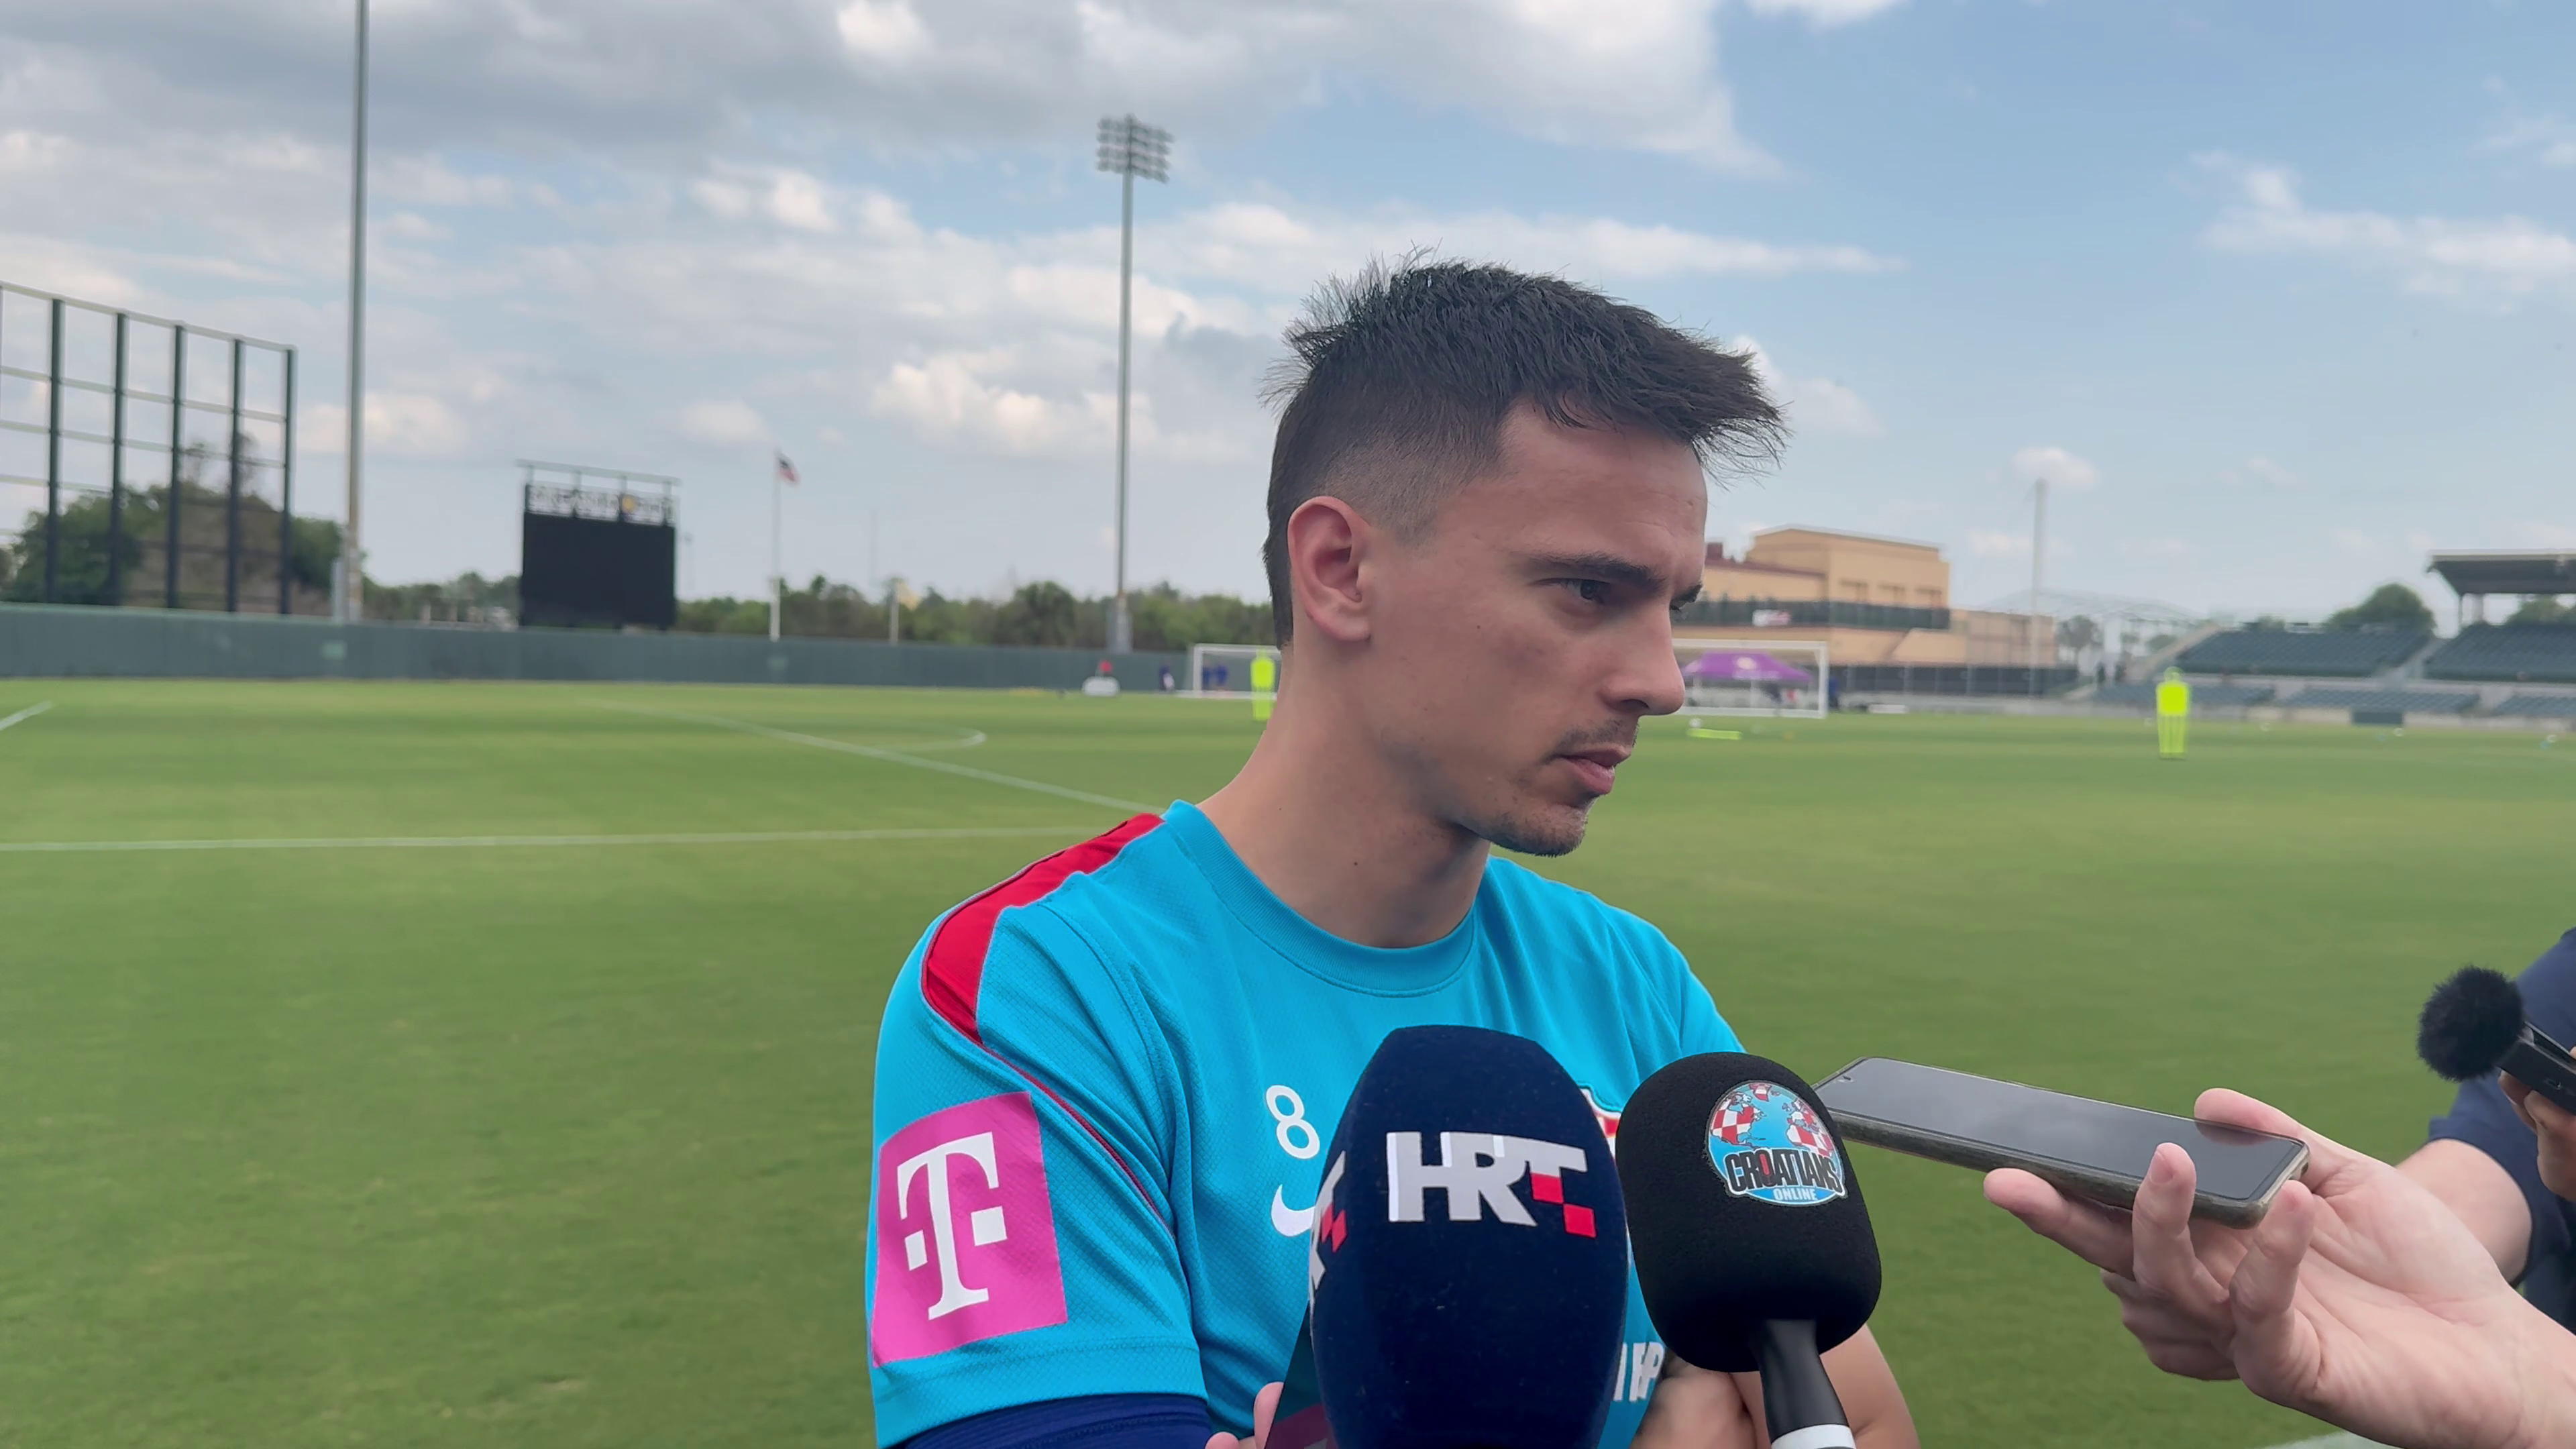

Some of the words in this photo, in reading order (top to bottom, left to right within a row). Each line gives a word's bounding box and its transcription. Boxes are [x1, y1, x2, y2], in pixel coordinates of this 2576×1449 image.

[1266, 1085, 1320, 1159] 8
[1386, 1131, 1597, 1239] HRT
[1725, 1148, 1843, 1193] CROATIANS
[1772, 1188, 1818, 1201] ONLINE
[898, 1131, 1007, 1321] T
